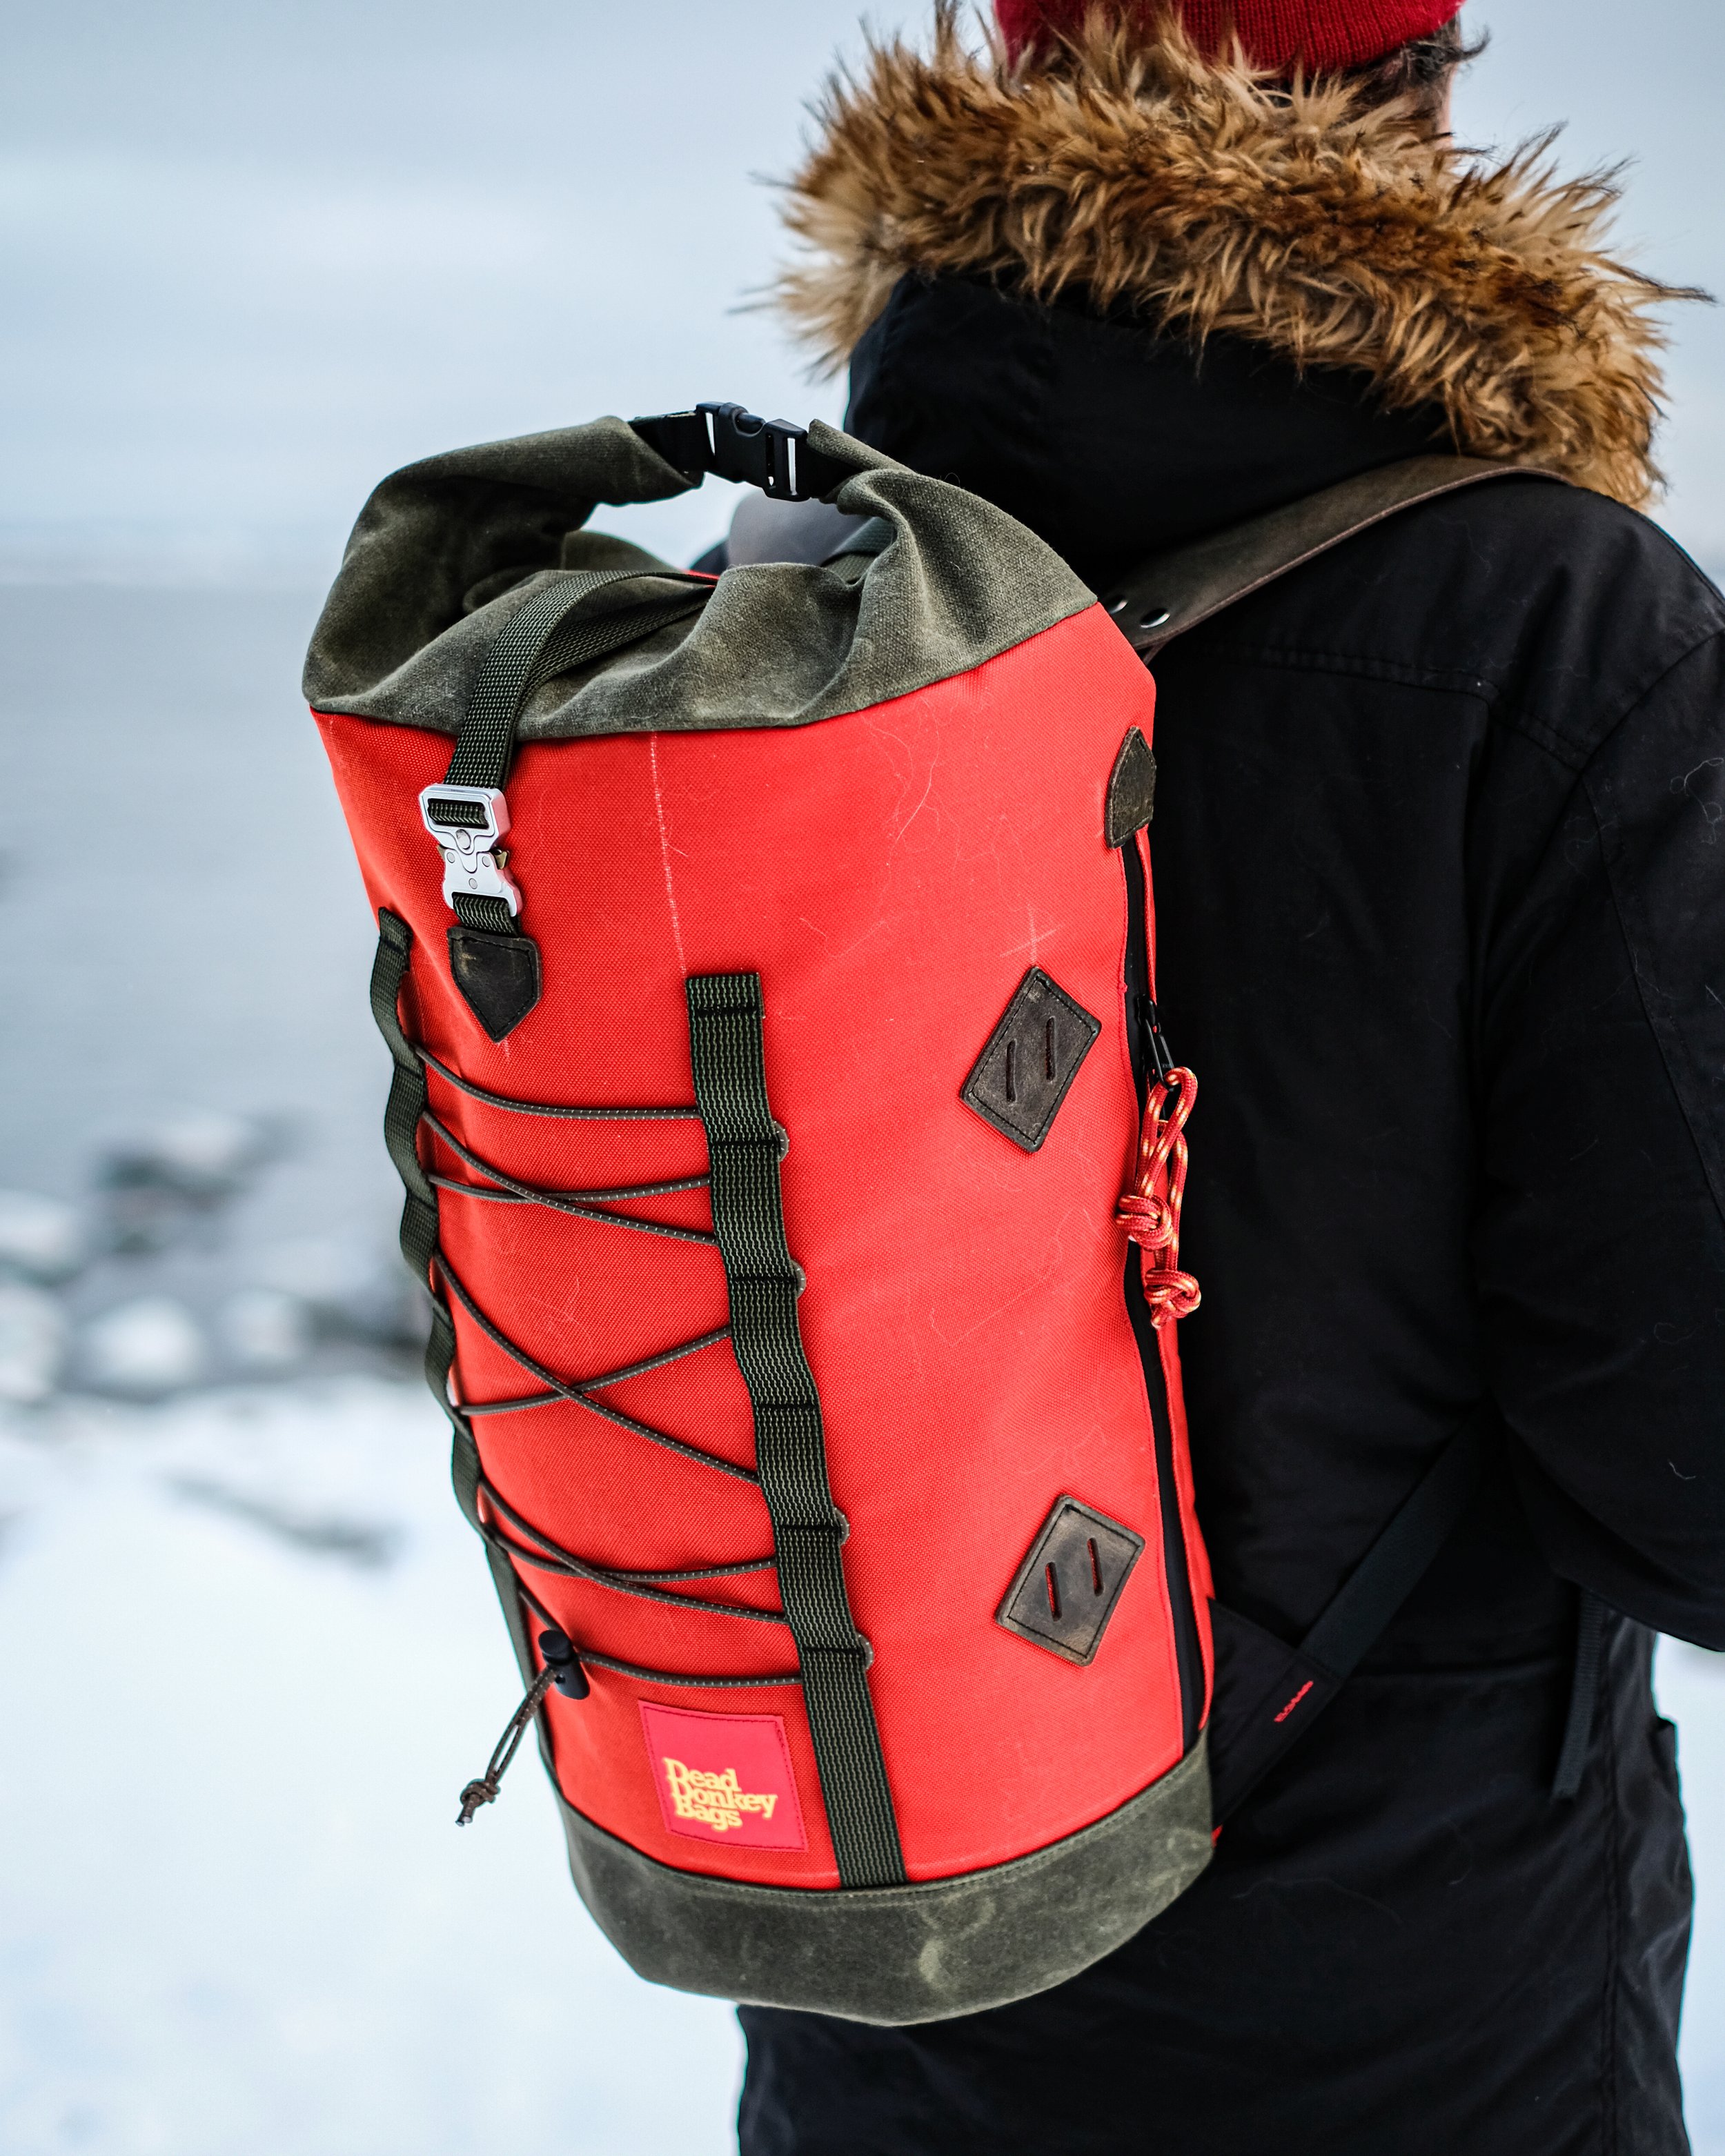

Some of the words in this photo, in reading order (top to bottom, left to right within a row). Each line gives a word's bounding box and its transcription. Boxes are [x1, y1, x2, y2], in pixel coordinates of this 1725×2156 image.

[663, 1757, 742, 1792] Dead
[667, 1775, 778, 1819] Donkey
[673, 1792, 743, 1830] Bags
